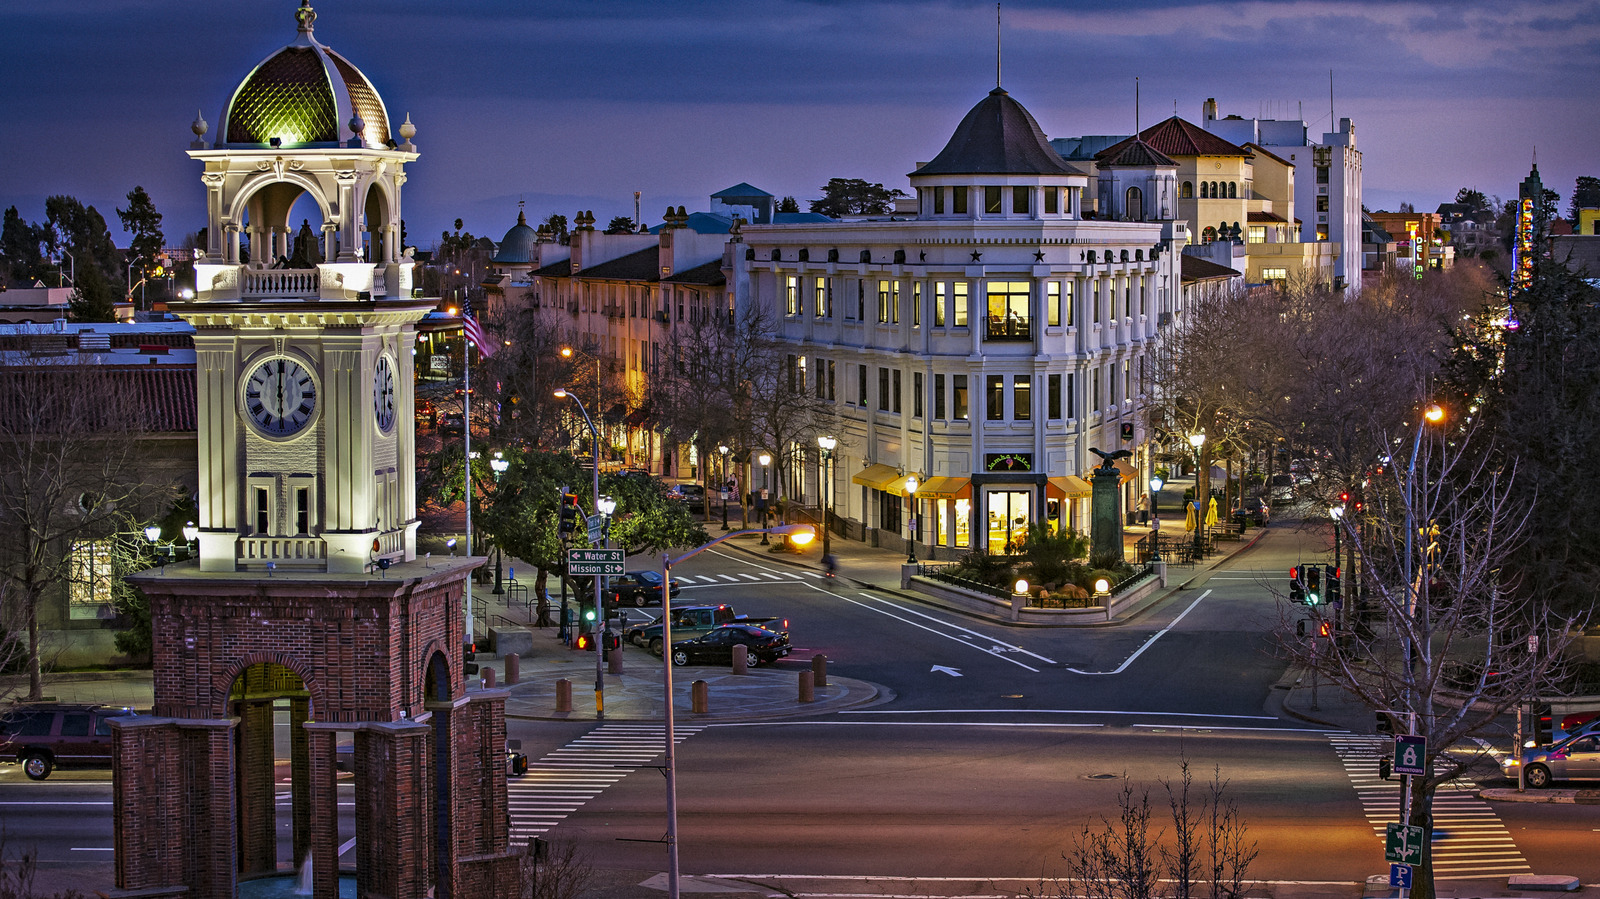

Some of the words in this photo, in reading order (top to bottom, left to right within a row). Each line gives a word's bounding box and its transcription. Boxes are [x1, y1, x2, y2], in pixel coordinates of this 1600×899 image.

[988, 454, 1011, 470] Jamba
[1013, 454, 1030, 470] Juice
[584, 552, 607, 560] Water
[610, 551, 620, 560] St
[570, 564, 601, 573] Mission
[604, 564, 614, 573] St
[1396, 866, 1408, 879] P
